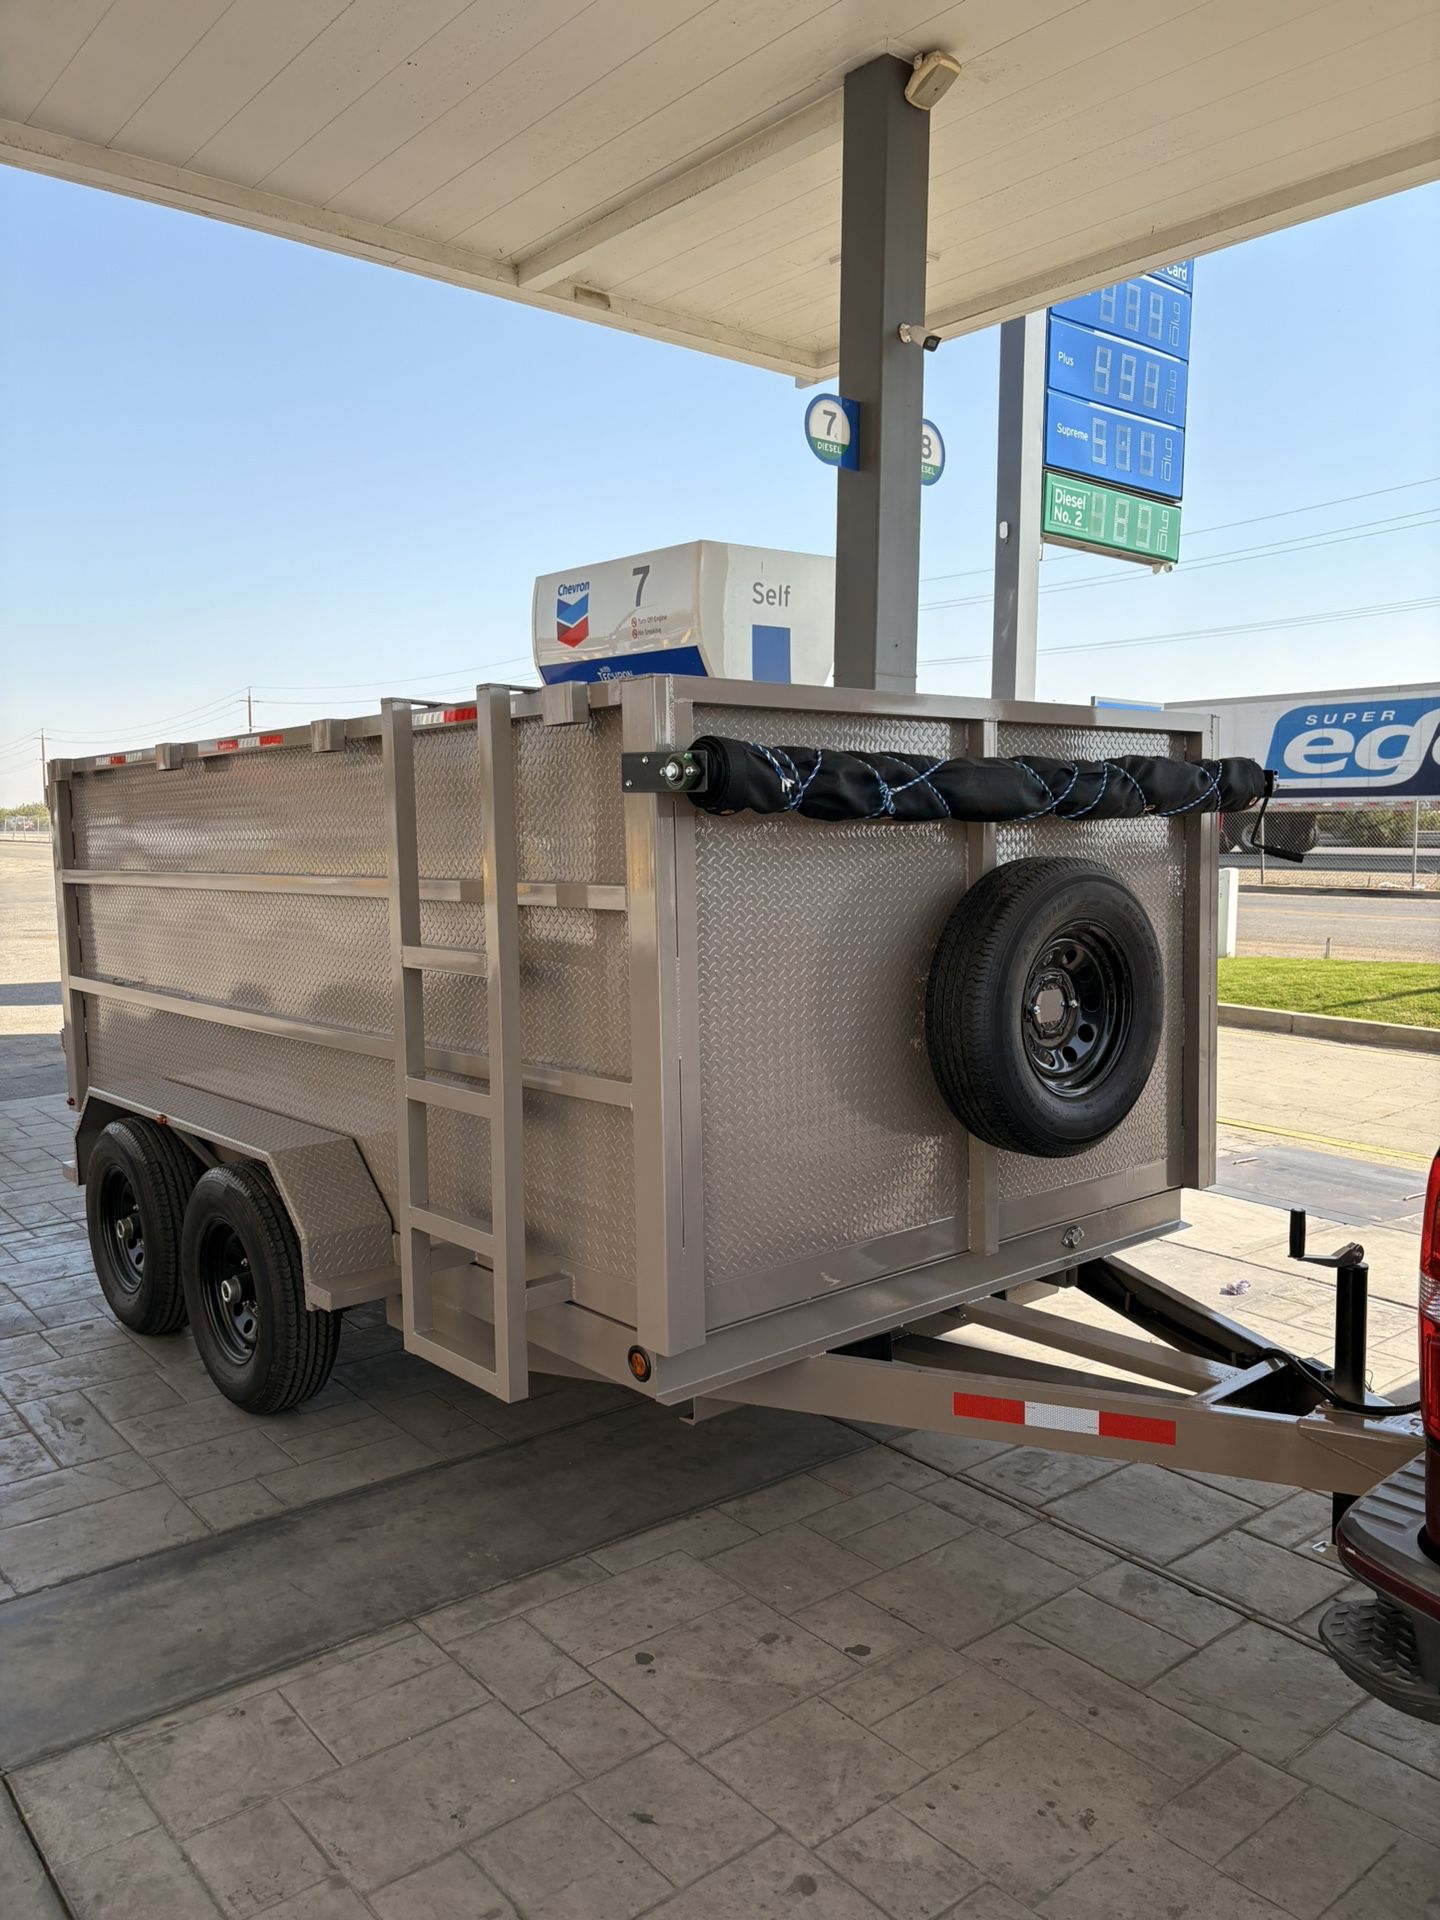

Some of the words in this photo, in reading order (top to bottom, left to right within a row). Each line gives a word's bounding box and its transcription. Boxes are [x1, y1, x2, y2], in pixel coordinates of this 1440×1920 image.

[1057, 350, 1075, 367] Plus
[823, 410, 837, 436] 7
[1056, 422, 1089, 442] Supreme
[817, 442, 841, 454] DIESEL
[921, 434, 932, 459] 8
[921, 464, 935, 475] ESEL
[1054, 488, 1086, 510] Diesel
[1053, 508, 1071, 525] No.
[1074, 510, 1083, 527] 2
[557, 580, 590, 596] Chevron
[632, 565, 650, 607] 7
[752, 582, 792, 607] Self
[1305, 710, 1396, 725] SUPER
[1283, 708, 1440, 788] eg
